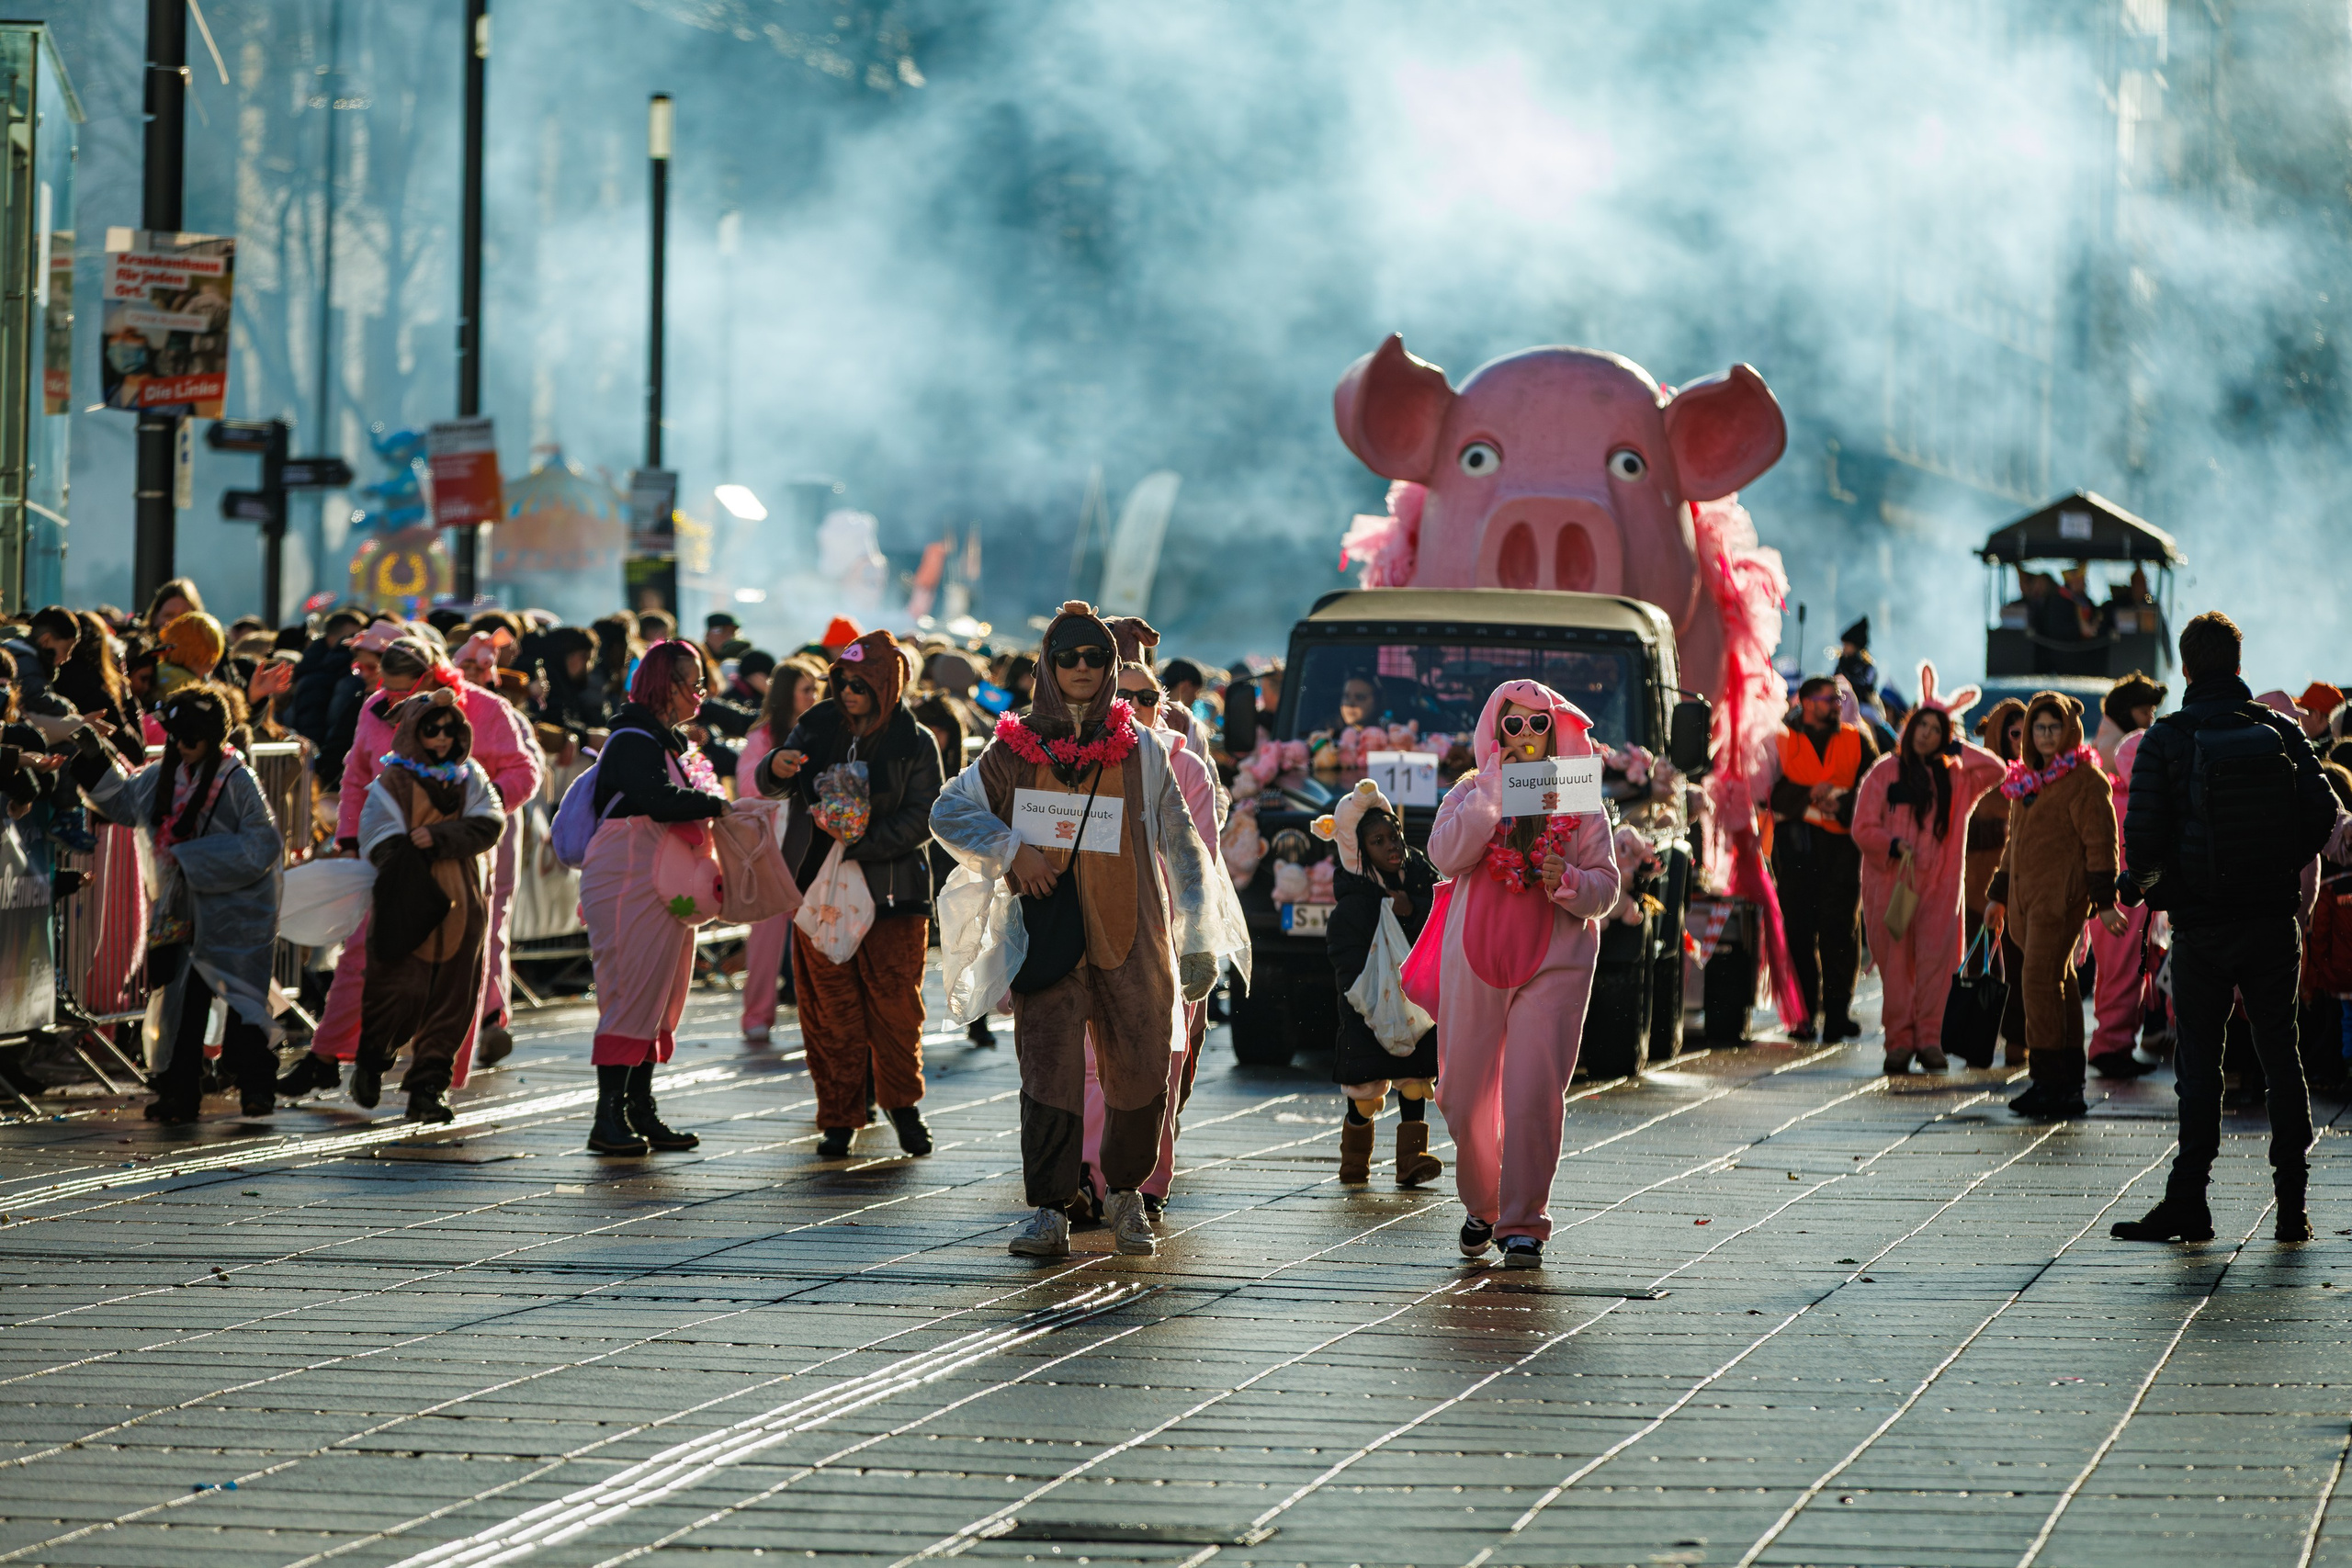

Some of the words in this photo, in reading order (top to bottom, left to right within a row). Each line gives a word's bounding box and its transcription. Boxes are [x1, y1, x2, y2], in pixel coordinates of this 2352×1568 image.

[144, 382, 172, 401] Die
[174, 378, 220, 399] Linke
[1385, 766, 1413, 795] 11
[1509, 773, 1593, 790] Sauguuuuuuut
